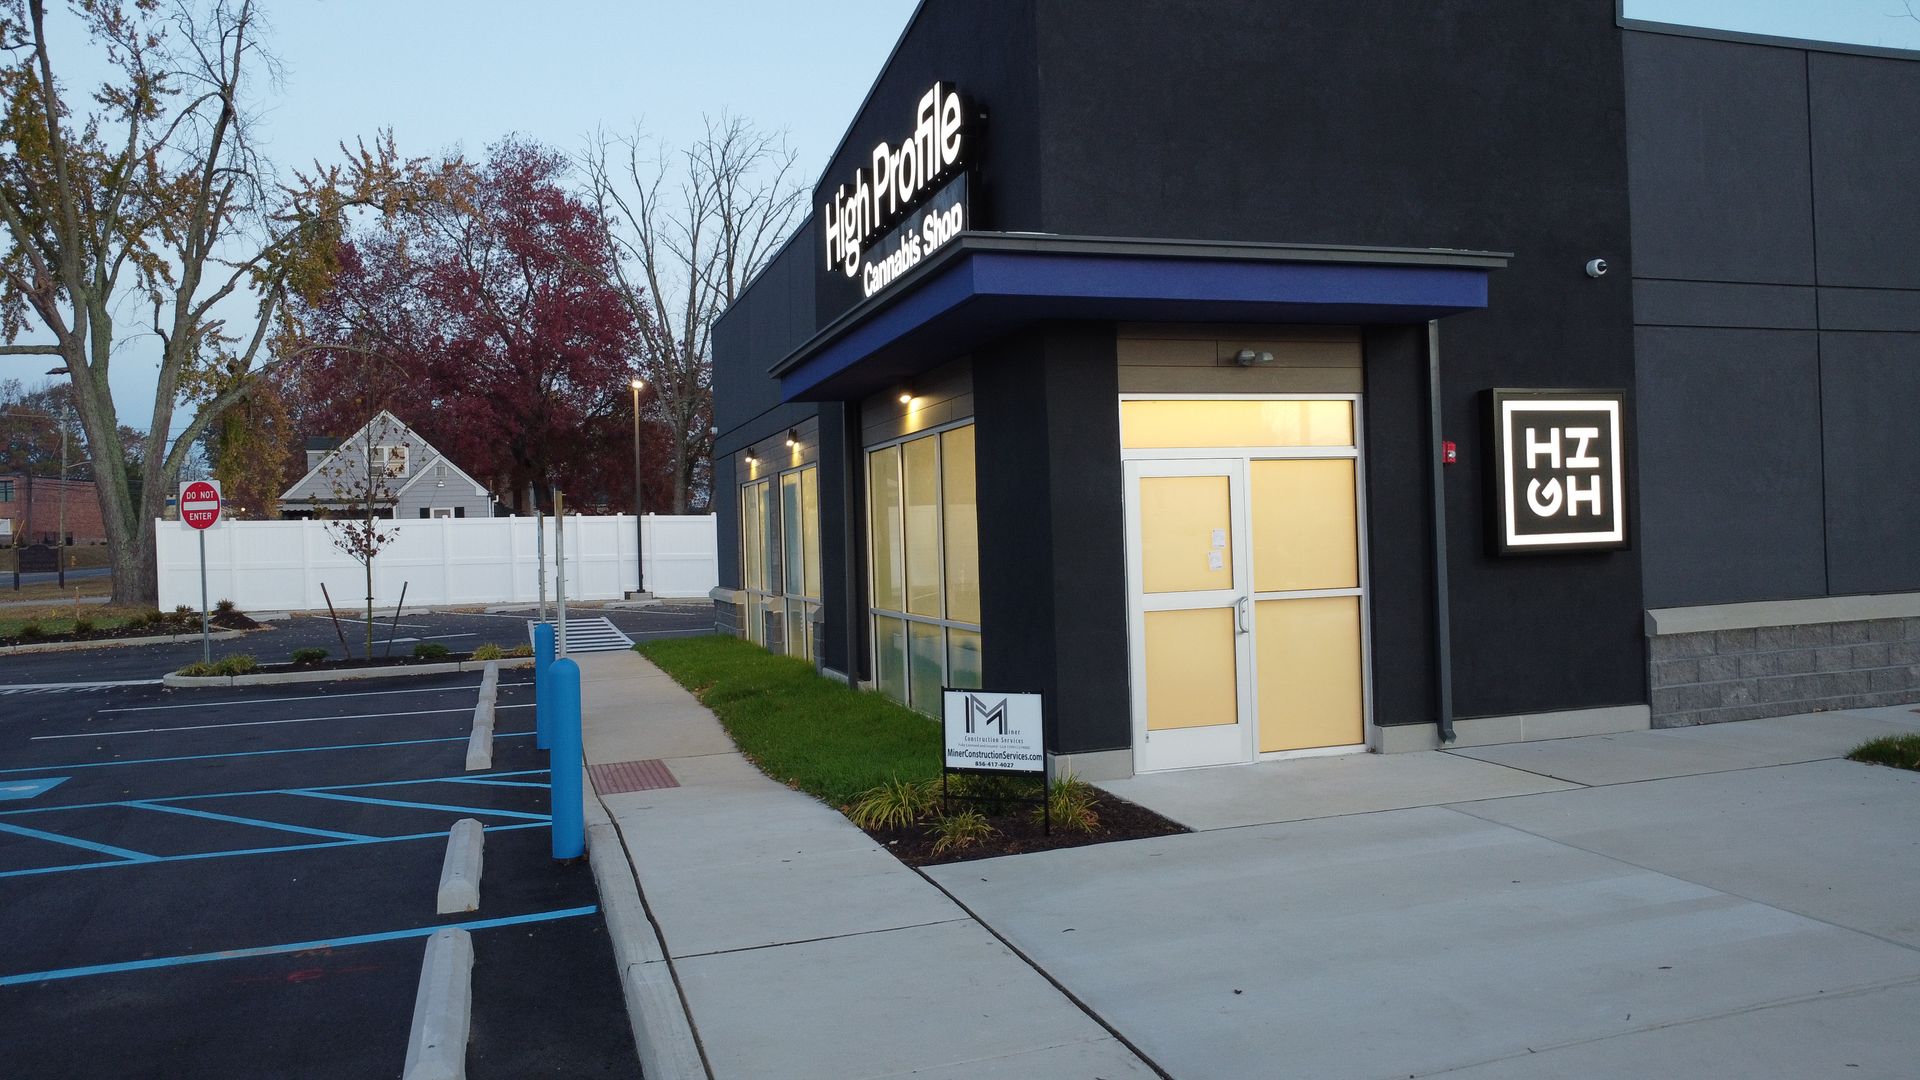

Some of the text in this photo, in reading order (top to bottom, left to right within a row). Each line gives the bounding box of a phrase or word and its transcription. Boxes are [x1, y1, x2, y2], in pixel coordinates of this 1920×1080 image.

[825, 80, 962, 278] High Profile
[863, 228, 921, 298] Cannabis
[186, 490, 214, 500] DO NOT
[189, 512, 212, 521] ENTER
[964, 735, 1024, 744] Construction Services
[947, 748, 1043, 761] MinerConstructionServices.com
[975, 761, 1014, 769] 856-417-4027
